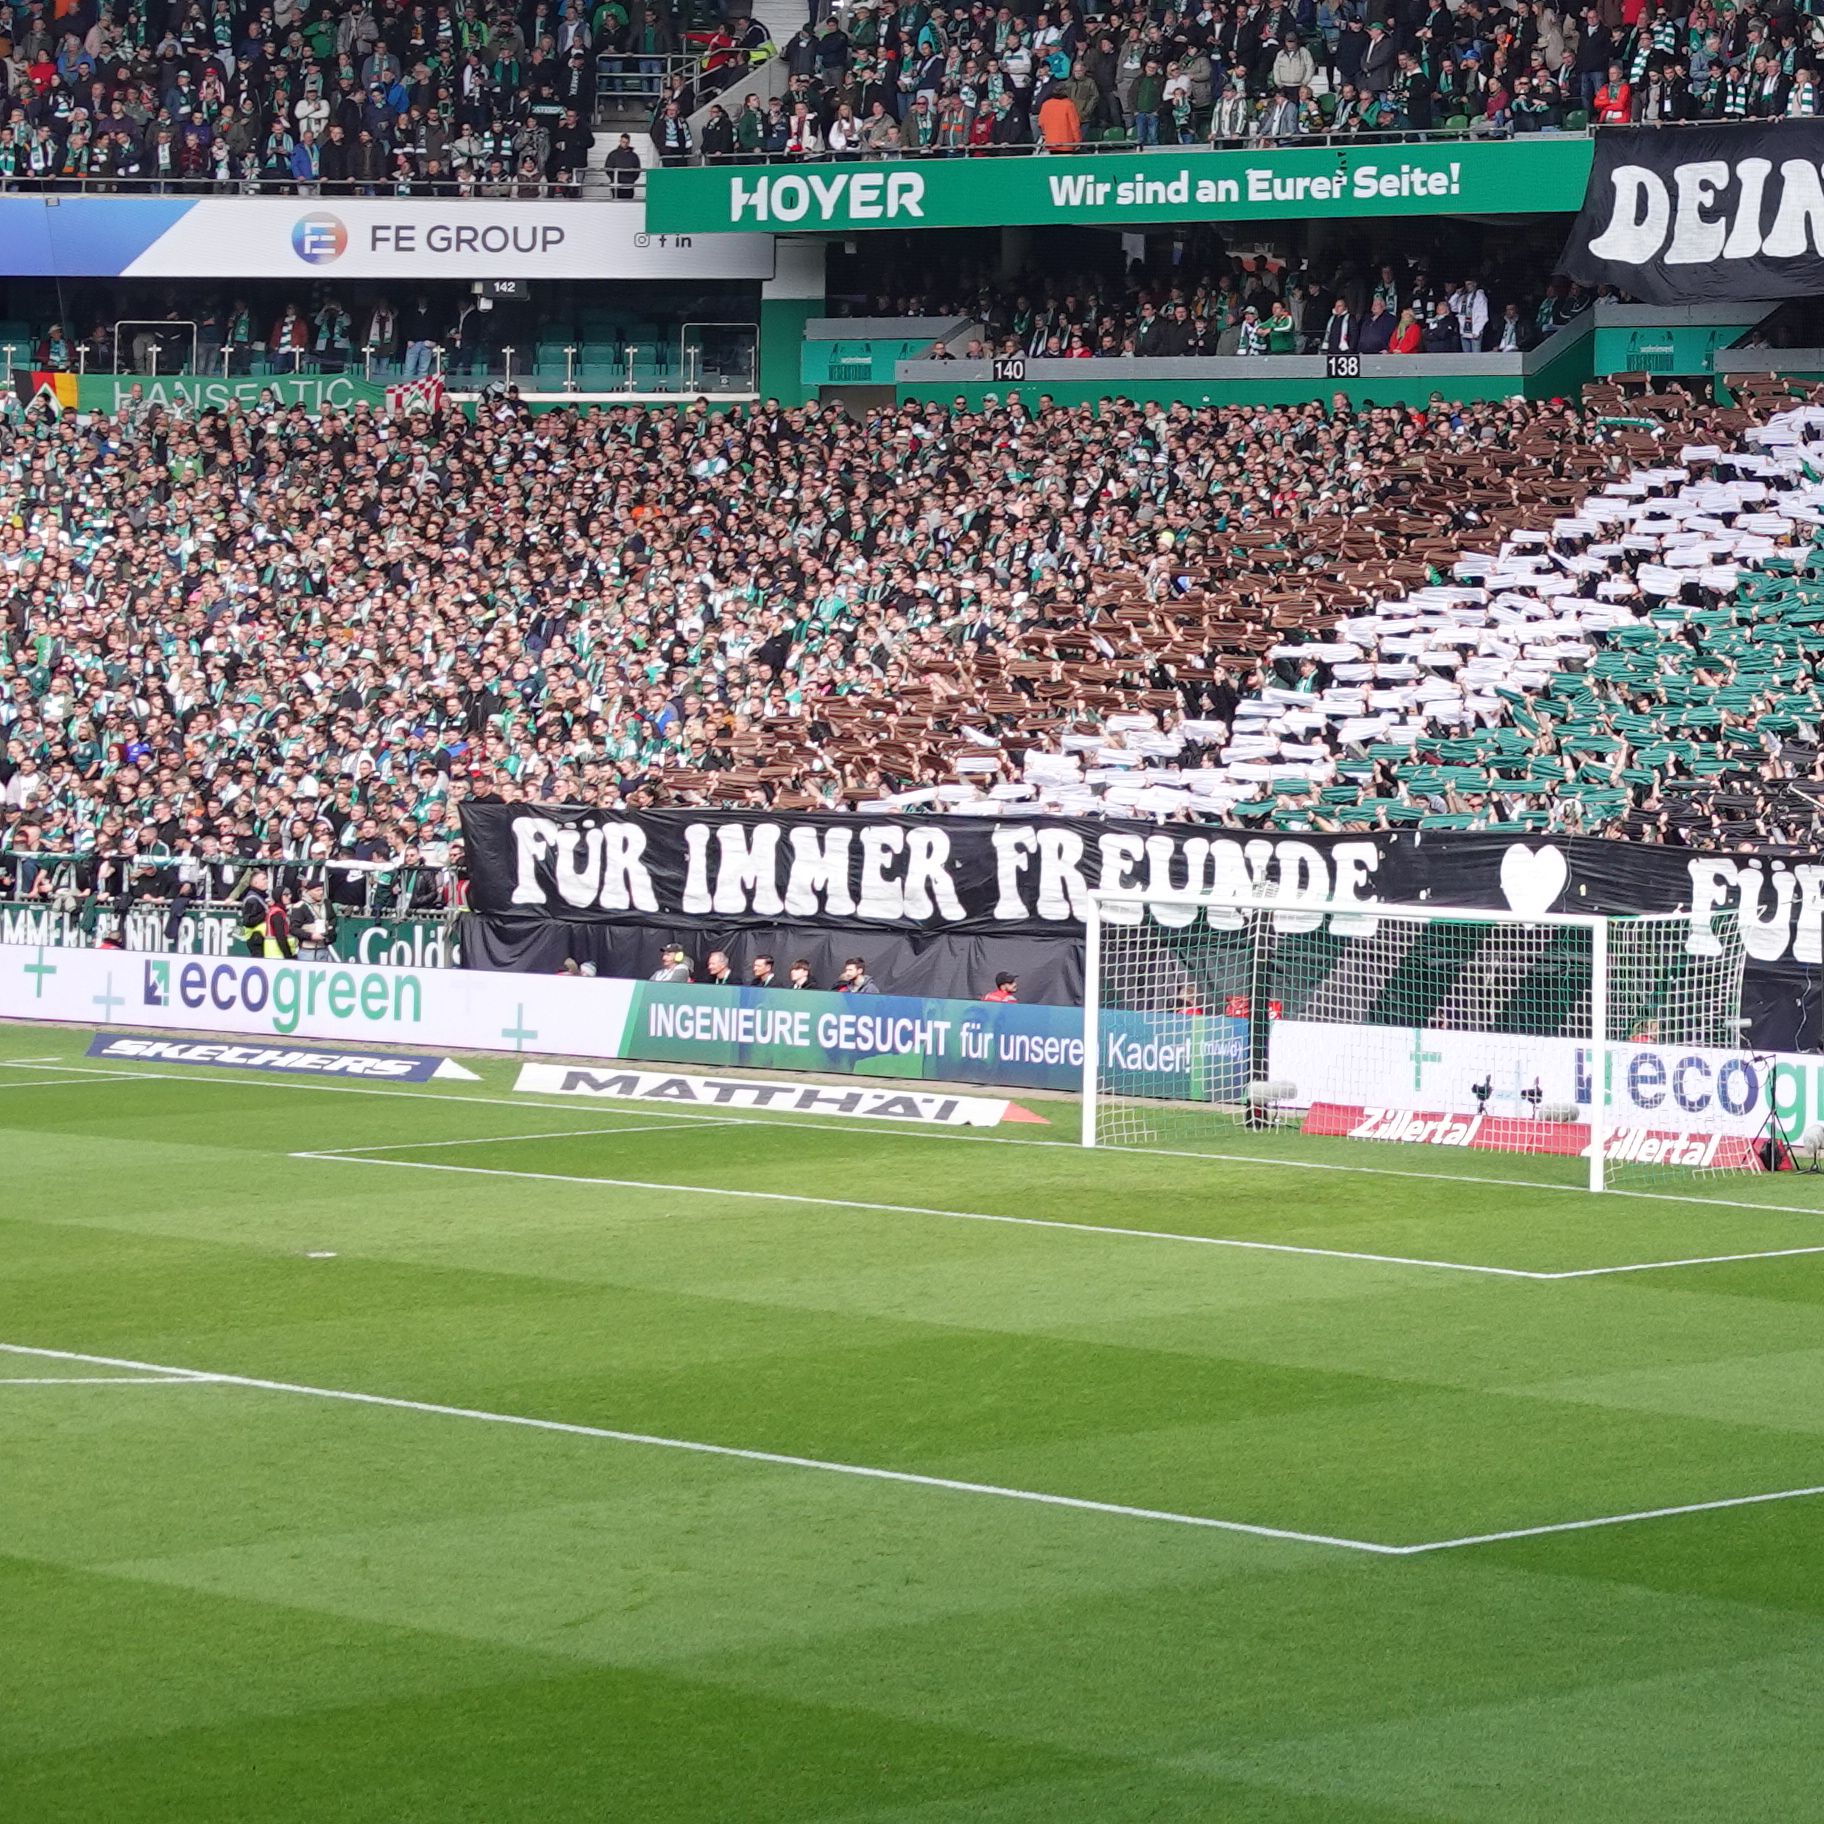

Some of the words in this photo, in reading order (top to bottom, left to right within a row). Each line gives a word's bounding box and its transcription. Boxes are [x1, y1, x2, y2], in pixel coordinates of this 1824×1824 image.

[730, 171, 924, 222] HOYER
[1049, 173, 1111, 207] Wir
[1116, 168, 1189, 205] sind
[1195, 178, 1239, 204] an
[1246, 168, 1347, 202] Eurer
[1352, 162, 1461, 198] Seite!
[371, 225, 416, 252] FE
[426, 224, 566, 253] GROUP
[494, 281, 515, 293] 142
[995, 360, 1024, 380] 140
[1328, 355, 1358, 376] 138
[114, 378, 355, 416] HANSEATIC
[511, 816, 660, 914] FÜR
[682, 822, 967, 922] IMMER
[993, 821, 1380, 938] FREUNDE
[179, 962, 422, 1034] ecogreen
[649, 1002, 810, 1048] INGENIEURE
[817, 1011, 953, 1057] GESUCHT
[959, 1022, 993, 1057] für
[1108, 1031, 1191, 1073] Kader!
[101, 1039, 421, 1077] SKECHERS
[1348, 1108, 1482, 1146] Zillertal
